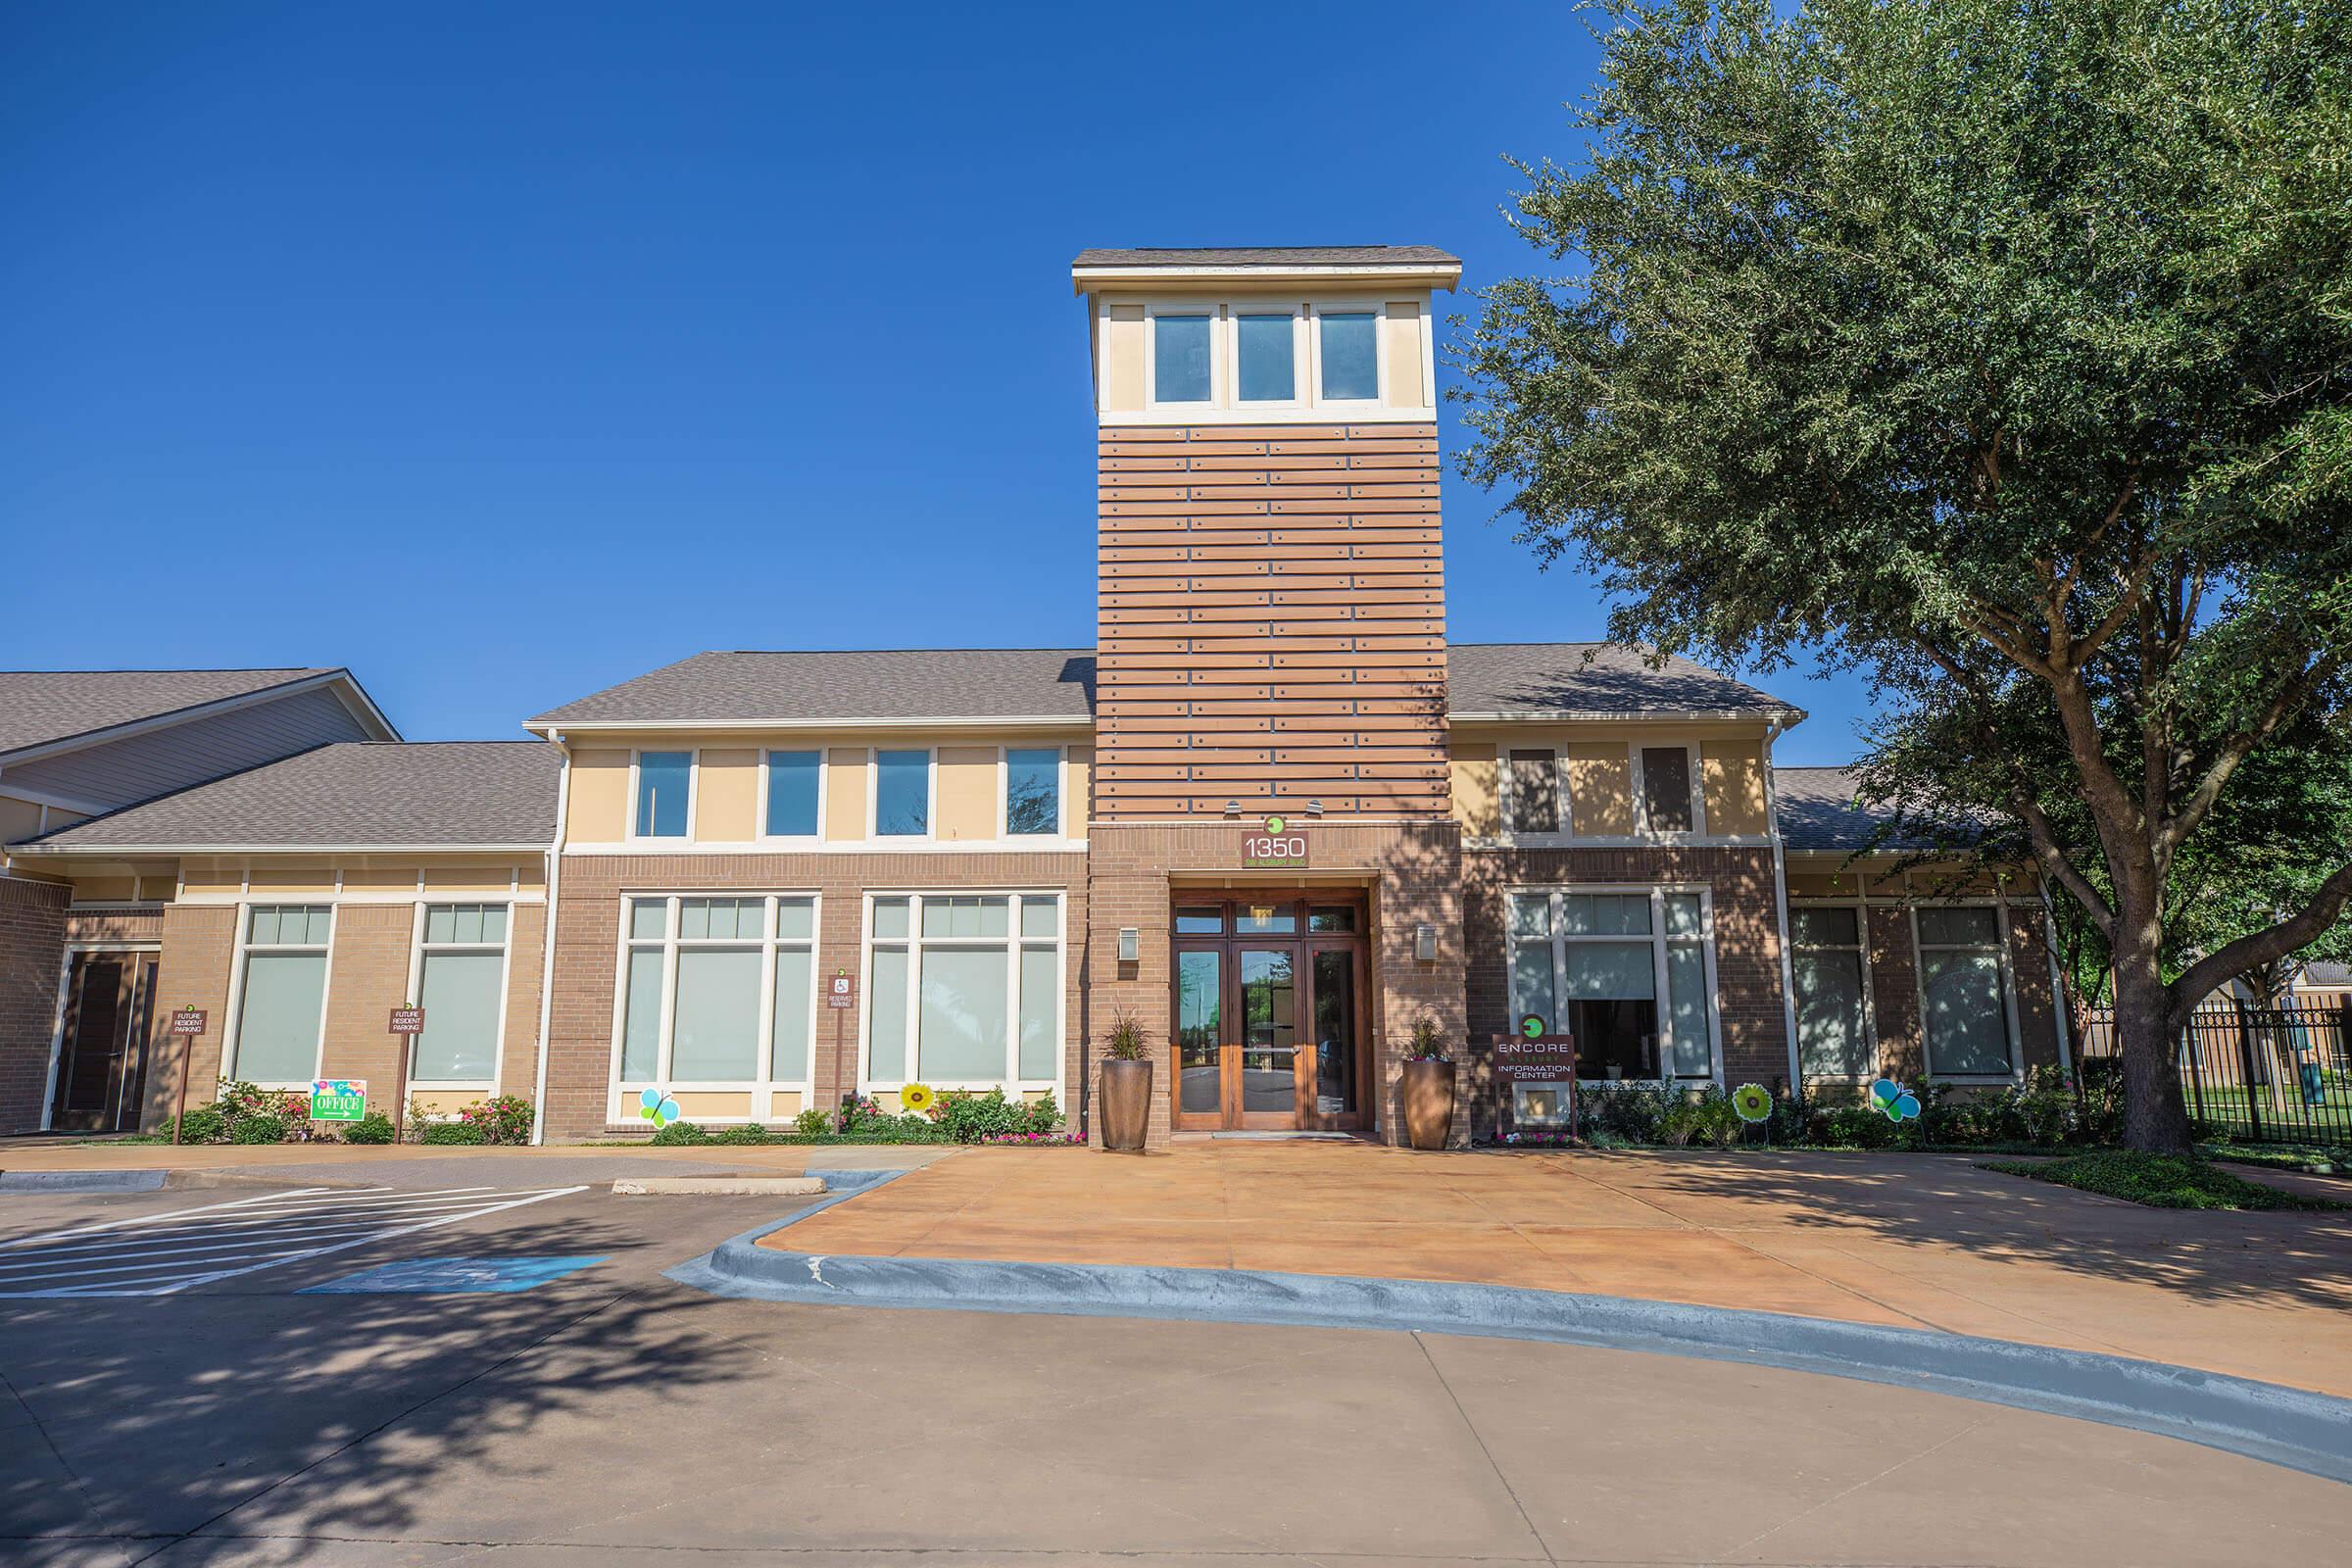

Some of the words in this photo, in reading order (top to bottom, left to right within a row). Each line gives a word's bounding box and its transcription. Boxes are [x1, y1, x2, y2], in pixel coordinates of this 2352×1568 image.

[1246, 837, 1305, 858] 1350
[1498, 1044, 1568, 1053] ENCORE
[317, 1097, 360, 1110] OFFICE
